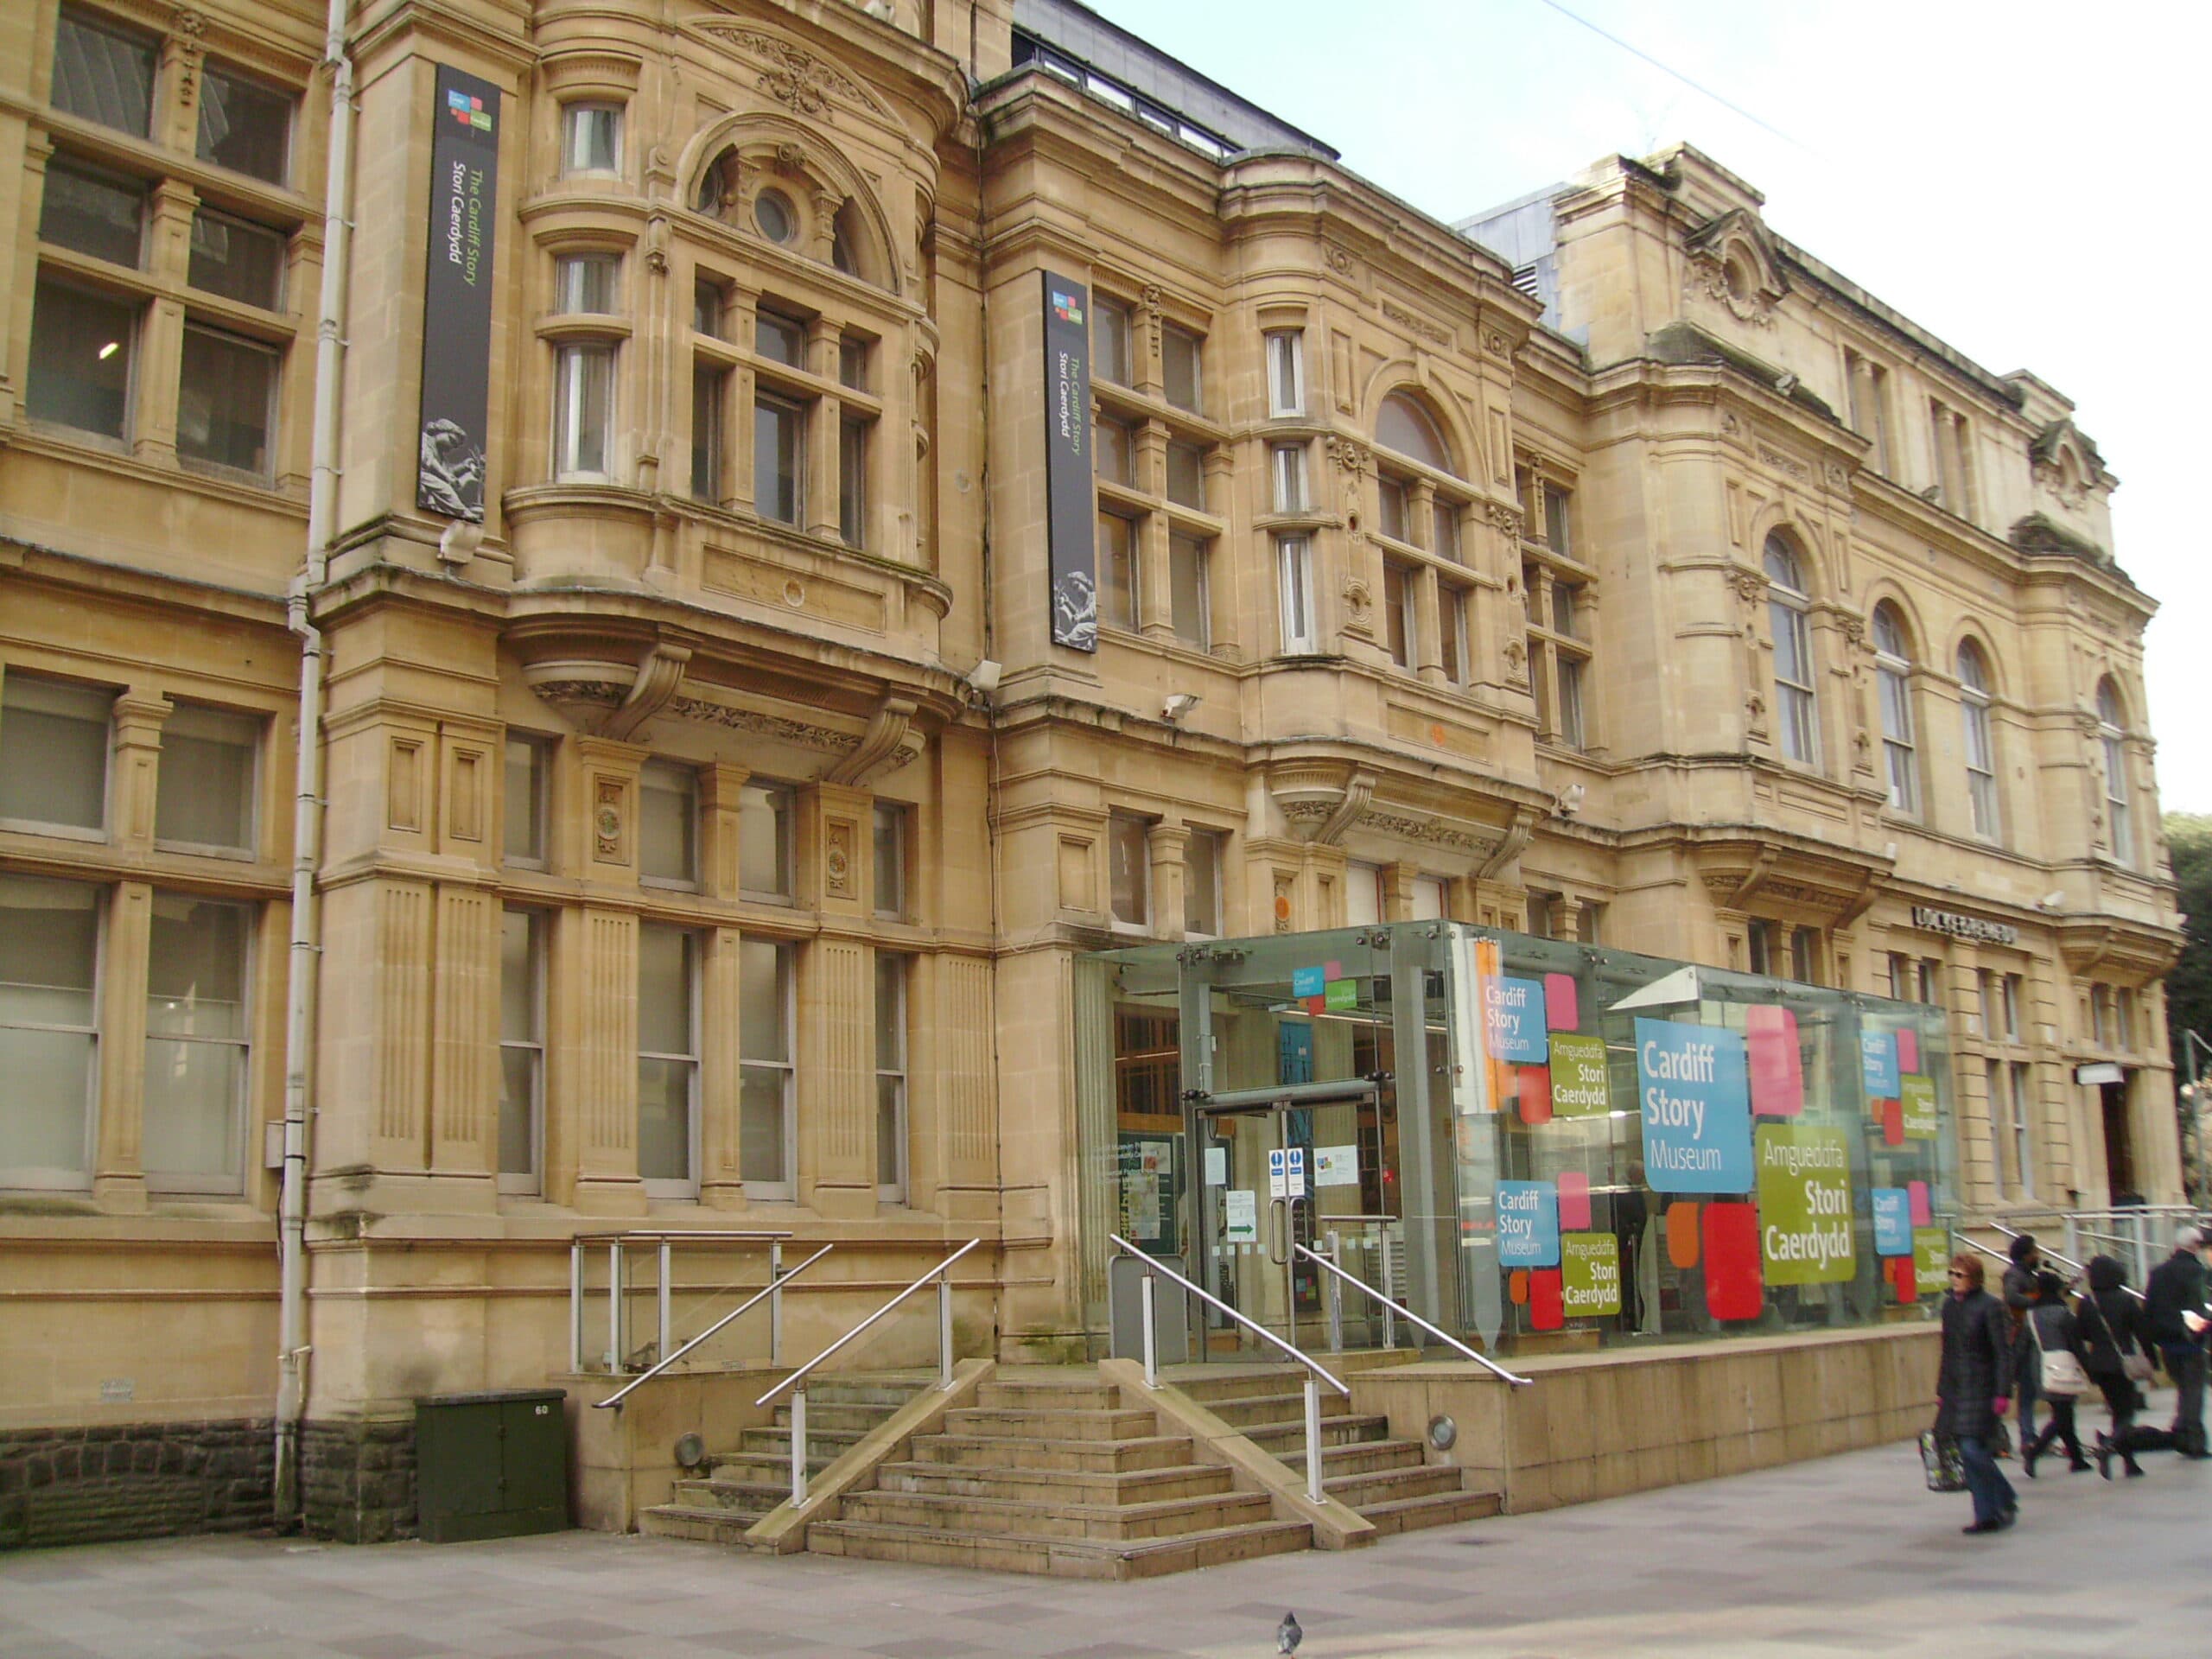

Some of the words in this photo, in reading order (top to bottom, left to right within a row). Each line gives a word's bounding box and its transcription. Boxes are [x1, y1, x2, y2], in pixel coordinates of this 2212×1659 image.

[453, 160, 467, 195] Stori
[469, 168, 483, 195] The
[447, 196, 465, 265] Caerdydd
[467, 197, 481, 248] Cardiff
[463, 248, 480, 287] Story
[1059, 350, 1069, 380] Stori
[1071, 358, 1080, 378] The
[1058, 381, 1071, 438] Caerdydd
[1071, 380, 1082, 423] Cardiff
[1071, 423, 1082, 456] Story
[1485, 984, 1527, 1008] Cardiff
[1487, 1008, 1521, 1035] Story
[1489, 1033, 1529, 1052] Museum
[1554, 1041, 1605, 1062] Amgueddfa
[1578, 1063, 1605, 1084] Stori
[1643, 1039, 1715, 1083] Cardiff
[1554, 1084, 1606, 1110] Caerdydd
[1646, 1087, 1705, 1141] Story
[1650, 1138, 1722, 1172] Museum
[1764, 1138, 1845, 1177] Amgueddfa
[1498, 1189, 1540, 1211] Cardiff
[1804, 1179, 1847, 1216] Stori
[1499, 1214, 1533, 1240] Story
[1501, 1240, 1541, 1256] Museum
[1566, 1238, 1616, 1262] Amgueddfa
[1764, 1221, 1851, 1271] Caerdydd
[1590, 1260, 1618, 1281] Stori
[1565, 1282, 1618, 1310] Caerdydd
